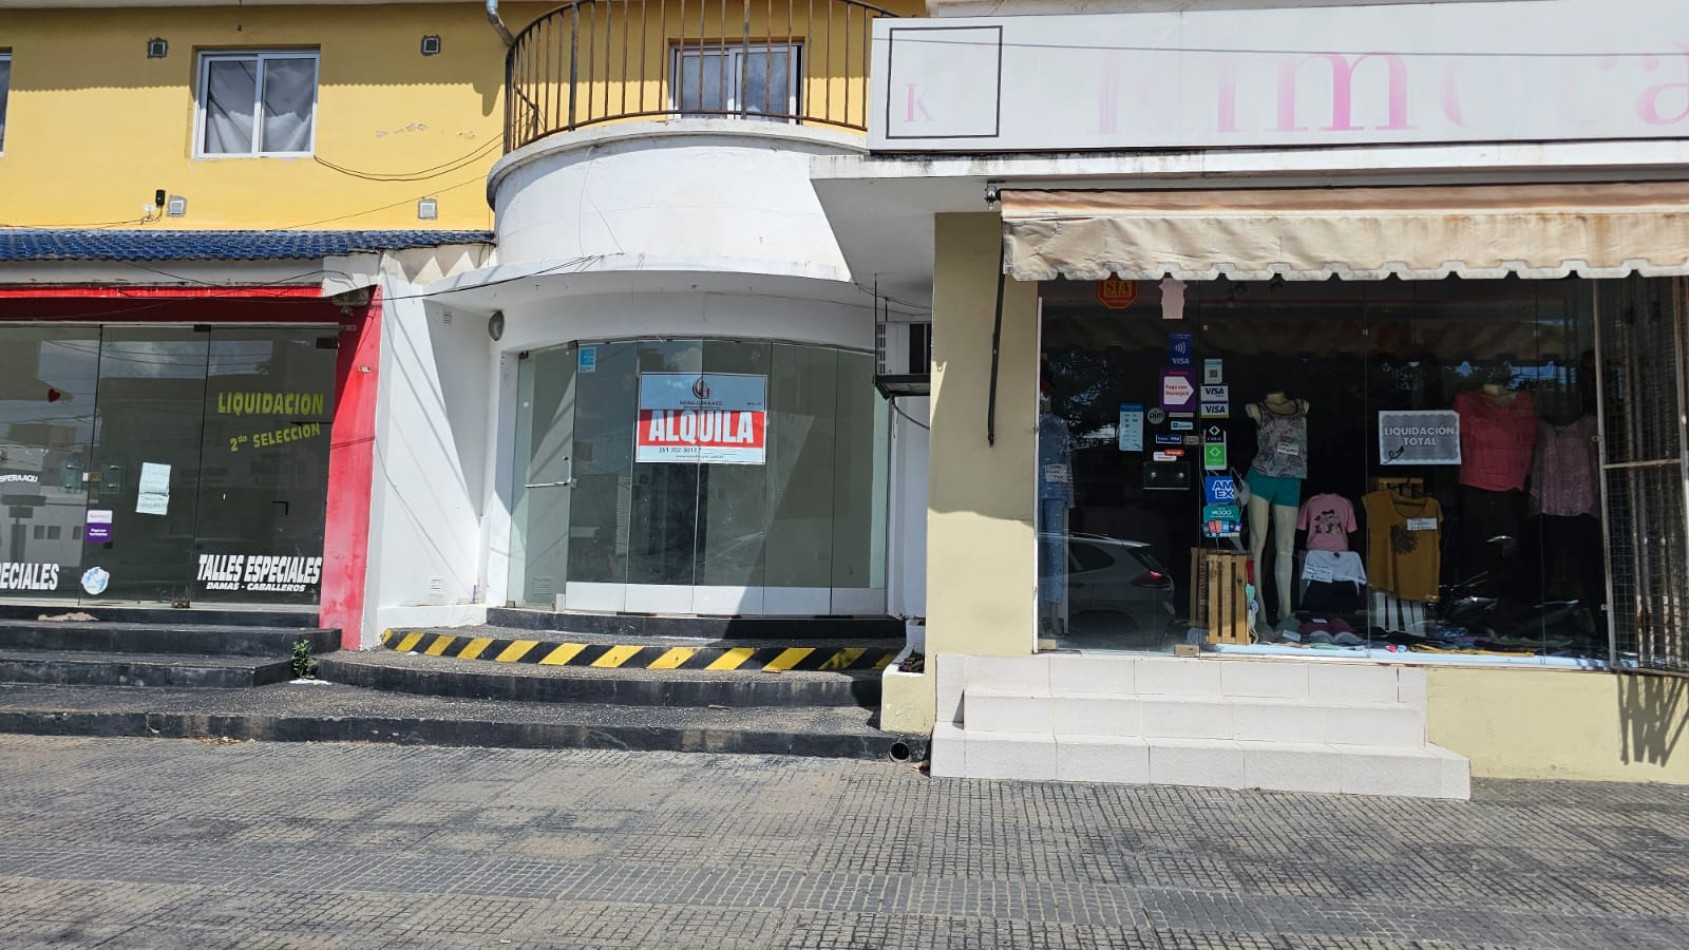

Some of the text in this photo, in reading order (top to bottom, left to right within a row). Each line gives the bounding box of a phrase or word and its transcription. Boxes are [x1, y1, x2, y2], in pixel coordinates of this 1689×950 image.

[1205, 387, 1225, 396] VISA
[218, 391, 324, 416] LIQUIDACION
[1205, 405, 1226, 414] VISA
[252, 422, 321, 449] SELECCION
[648, 409, 754, 445] ALQUILA
[1384, 424, 1455, 436] LIQUIDACIÓN
[1402, 437, 1437, 446] TOTAL
[0, 562, 59, 590] ECIALES
[197, 554, 323, 584] TALLES ESPECIALES
[205, 582, 240, 590] DAMAS
[246, 583, 307, 592] CABALLEROS
